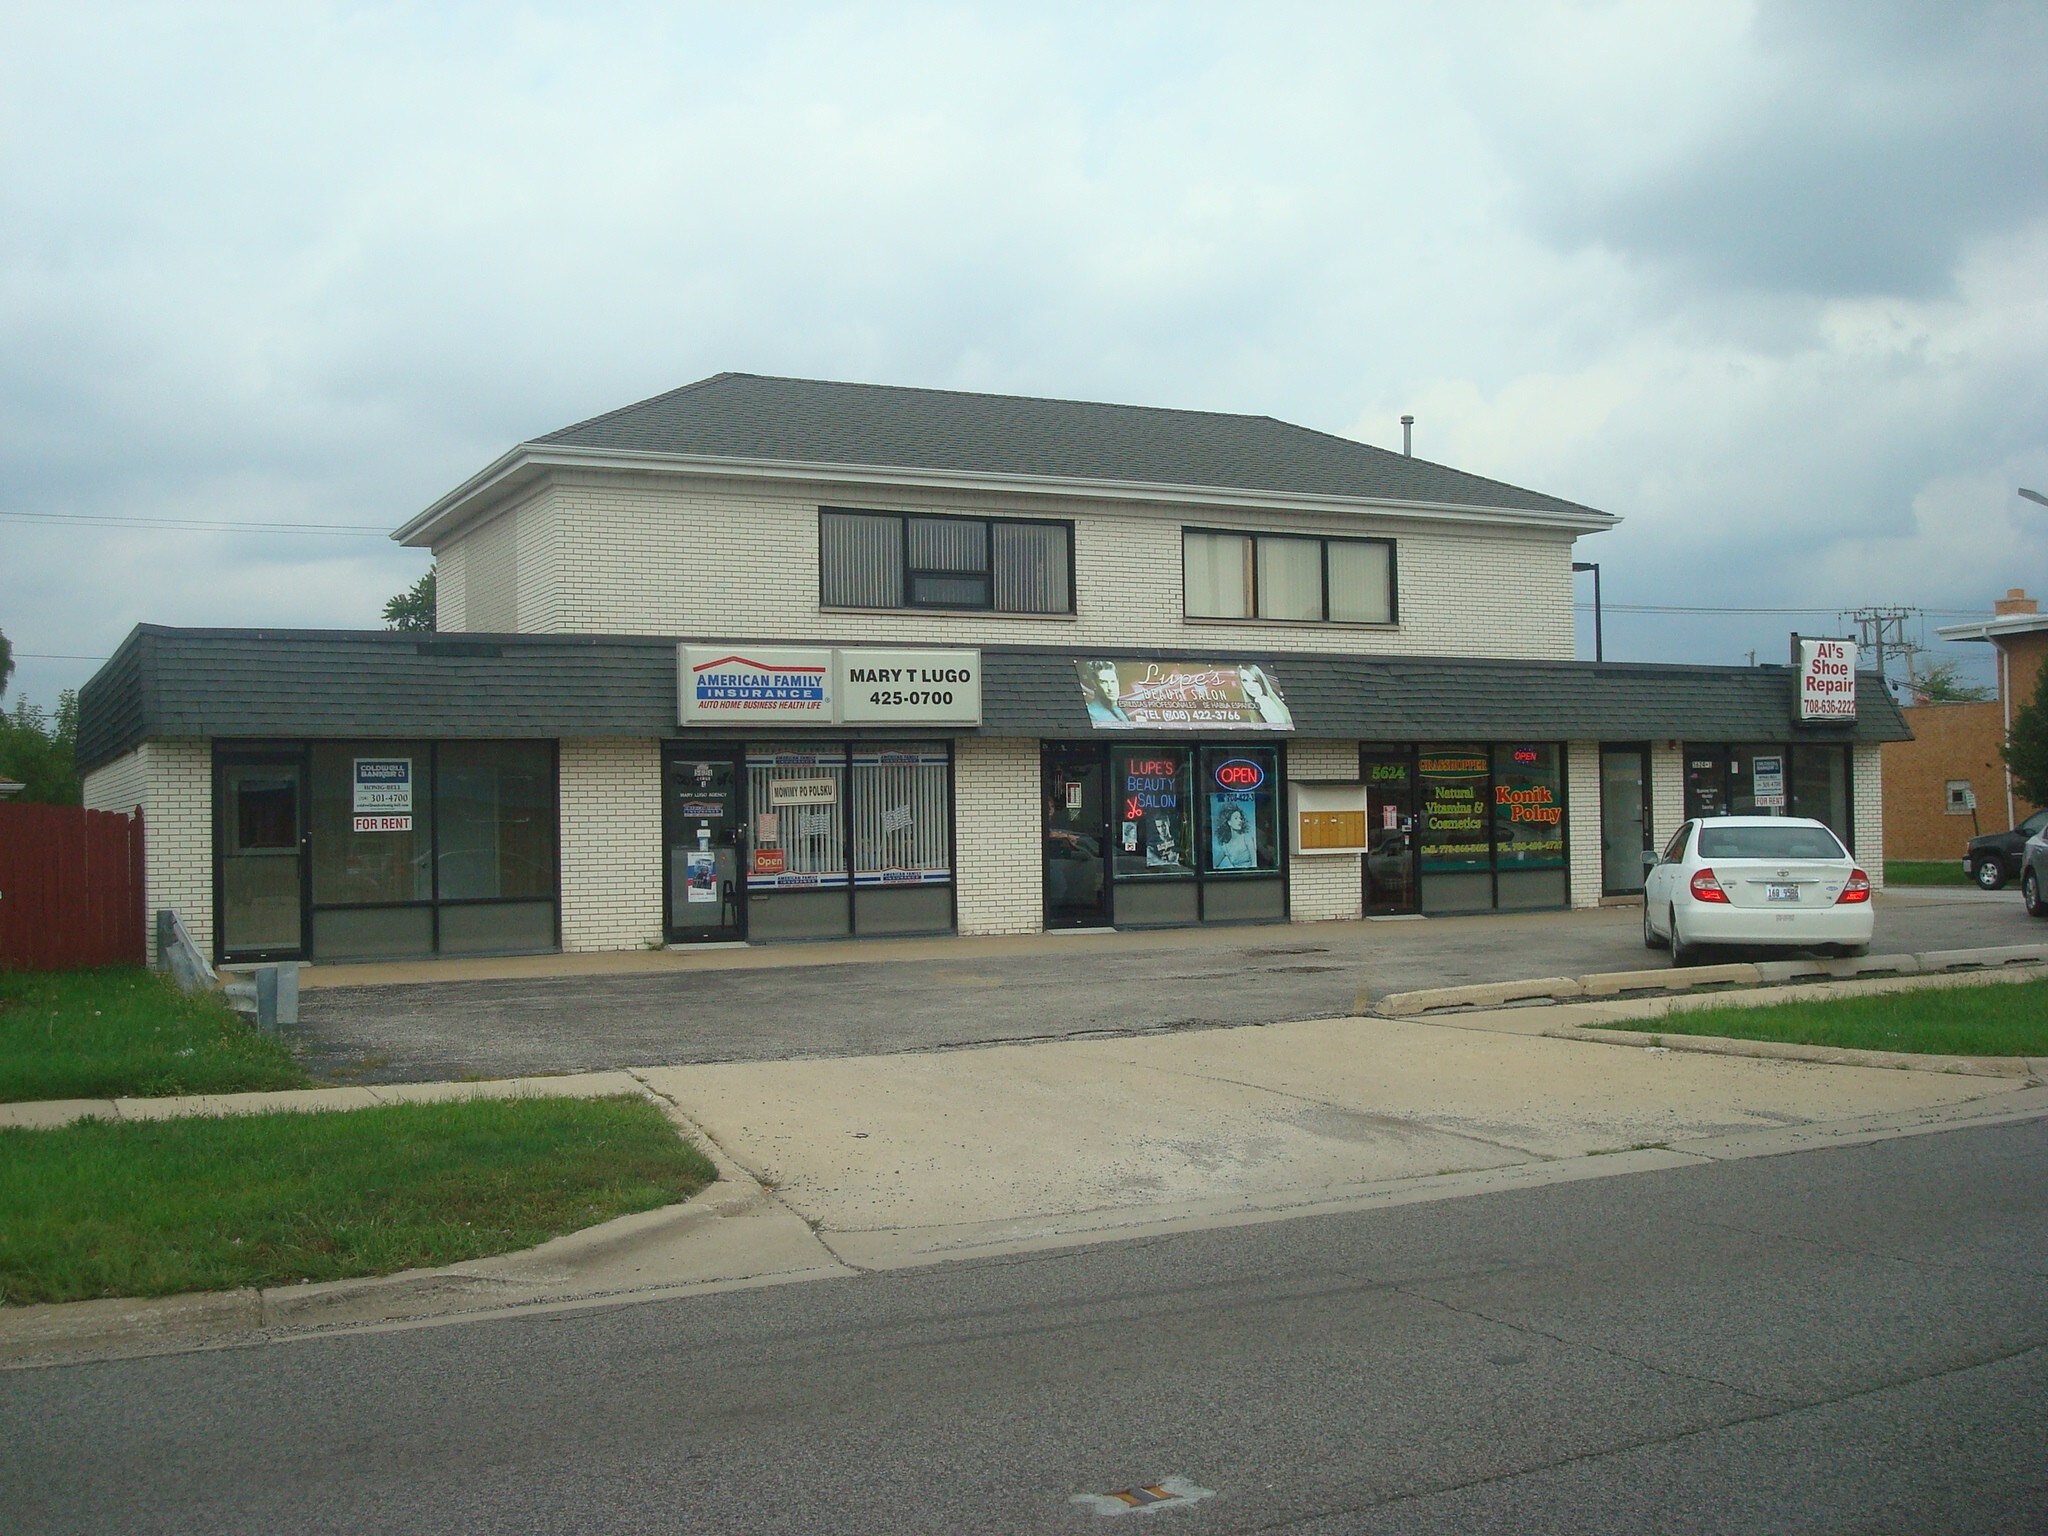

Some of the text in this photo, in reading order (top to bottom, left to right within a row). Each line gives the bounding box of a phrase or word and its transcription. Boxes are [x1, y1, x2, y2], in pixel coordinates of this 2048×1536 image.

[1817, 643, 1844, 659] Al's
[1812, 659, 1848, 675] Shoe
[697, 675, 823, 687] AMERICAN FAMILY
[850, 669, 972, 684] MARY T LUGO
[1138, 664, 1226, 691] Lupe's
[1806, 676, 1854, 696] Repair
[707, 689, 812, 698] INSURANCE
[870, 692, 953, 706] 425-0700
[1143, 688, 1227, 701] BEAUTY SALON
[698, 700, 822, 711] AUTO HOME BUSINESS HEALTH LIFE
[1804, 699, 1855, 714] 708-636-2222
[1144, 710, 1241, 722] TEL (708) 422-3766
[1515, 751, 1537, 761] OPEN
[1130, 760, 1173, 775] LUPE'S
[1419, 759, 1488, 771] GRASSHOPPER
[1221, 768, 1258, 783] OPEN
[1372, 766, 1406, 780] 5624
[1127, 776, 1176, 791] BEAUTY
[799, 786, 808, 797] PO
[809, 785, 832, 797] POLSKU
[1436, 786, 1474, 799] Natural
[1496, 786, 1552, 804] Konik
[371, 794, 408, 802] 301-4700
[1137, 793, 1177, 808] SALON
[1757, 797, 1783, 805] FOR RENT
[1426, 802, 1485, 814] Vitamins &
[1511, 805, 1562, 825] Polny
[356, 818, 410, 830] FOR RENT
[1429, 817, 1482, 830] Cosmetics
[757, 857, 783, 867] Open
